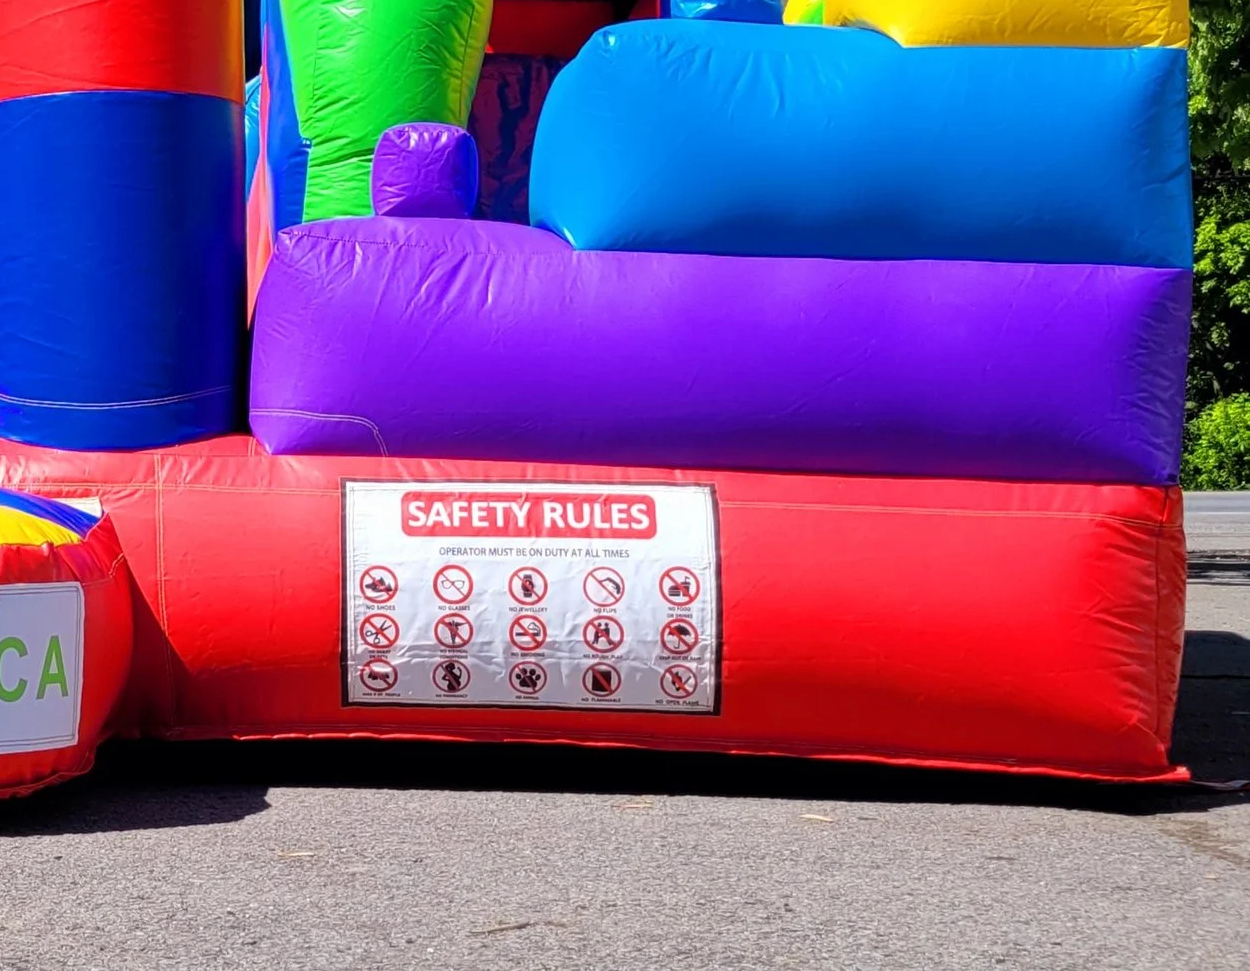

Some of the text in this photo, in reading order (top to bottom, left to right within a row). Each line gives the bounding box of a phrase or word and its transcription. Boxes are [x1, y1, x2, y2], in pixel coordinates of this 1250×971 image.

[407, 501, 651, 530] SAFETY RULES
[438, 546, 630, 558] OPERATOR MUST BE ON DUTY AT ALL TIMES
